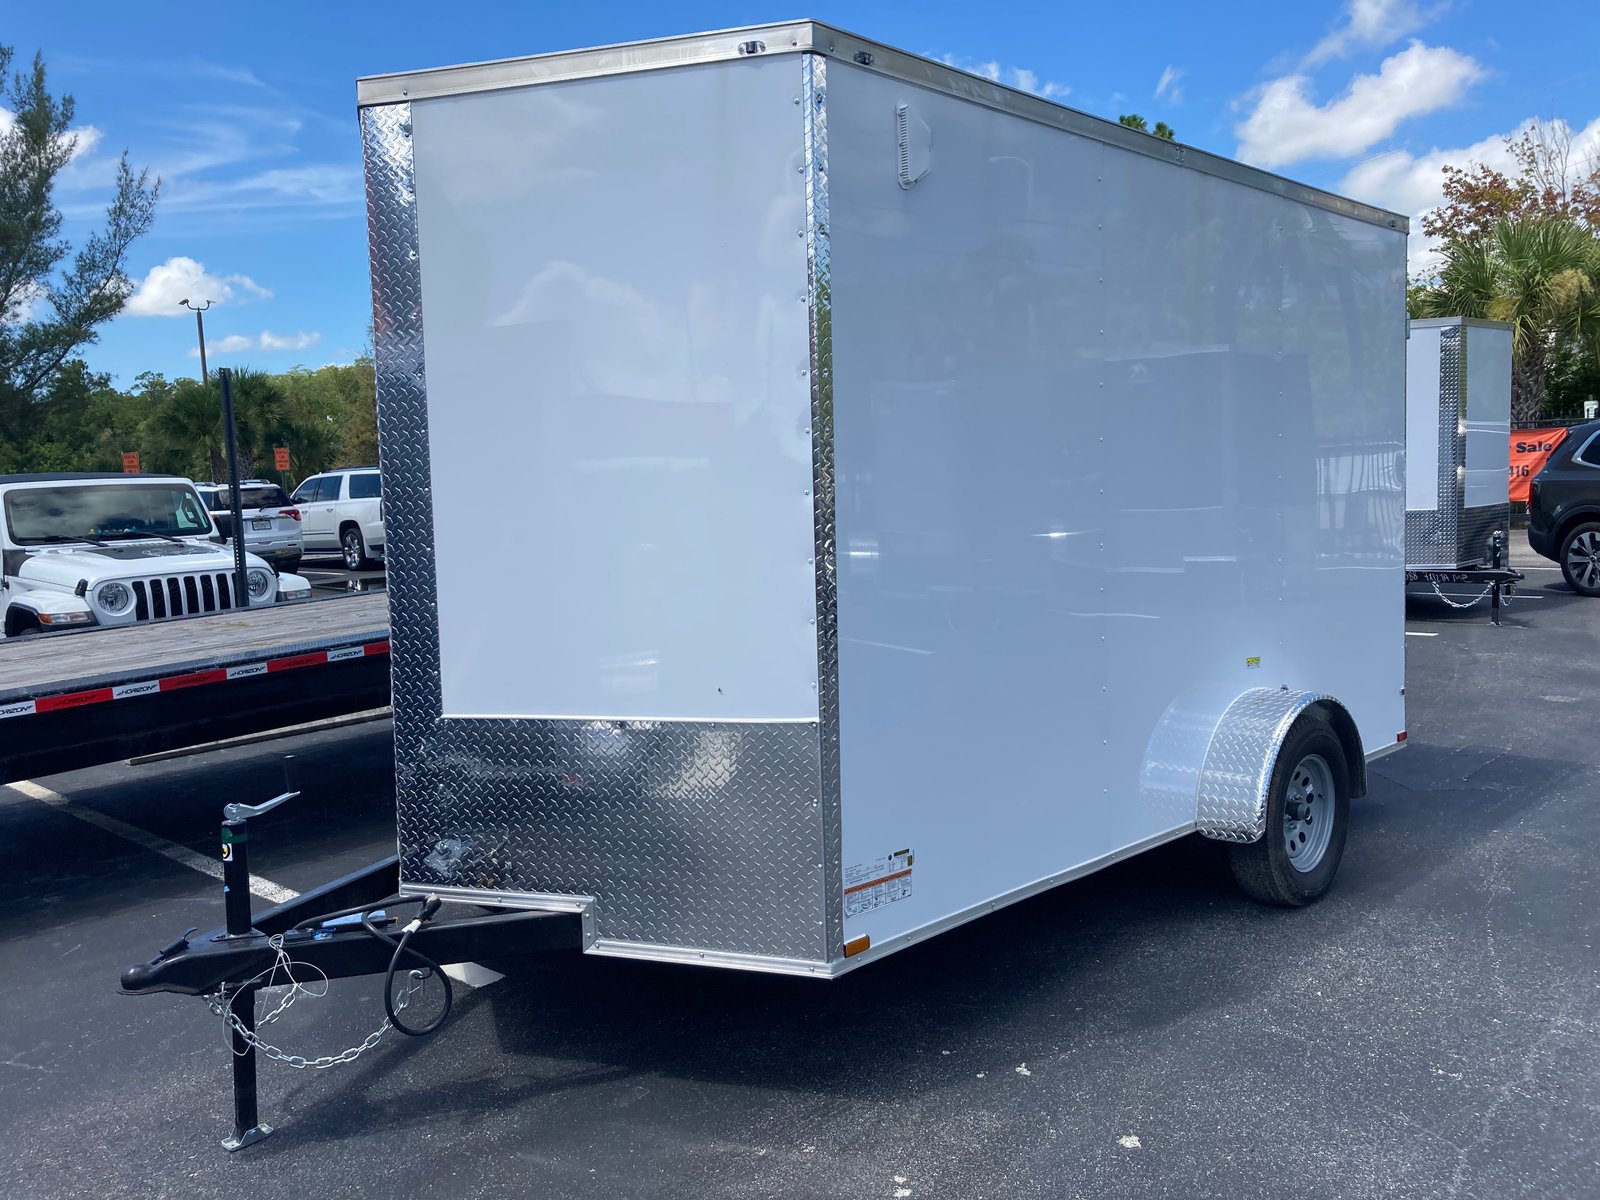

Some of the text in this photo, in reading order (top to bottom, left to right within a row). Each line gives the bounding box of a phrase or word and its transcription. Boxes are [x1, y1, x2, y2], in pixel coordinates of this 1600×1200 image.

[1516, 441, 1552, 453] Sale
[1509, 465, 1529, 477] 416
[229, 666, 265, 677] HORIZON
[116, 684, 158, 696] HORIZON
